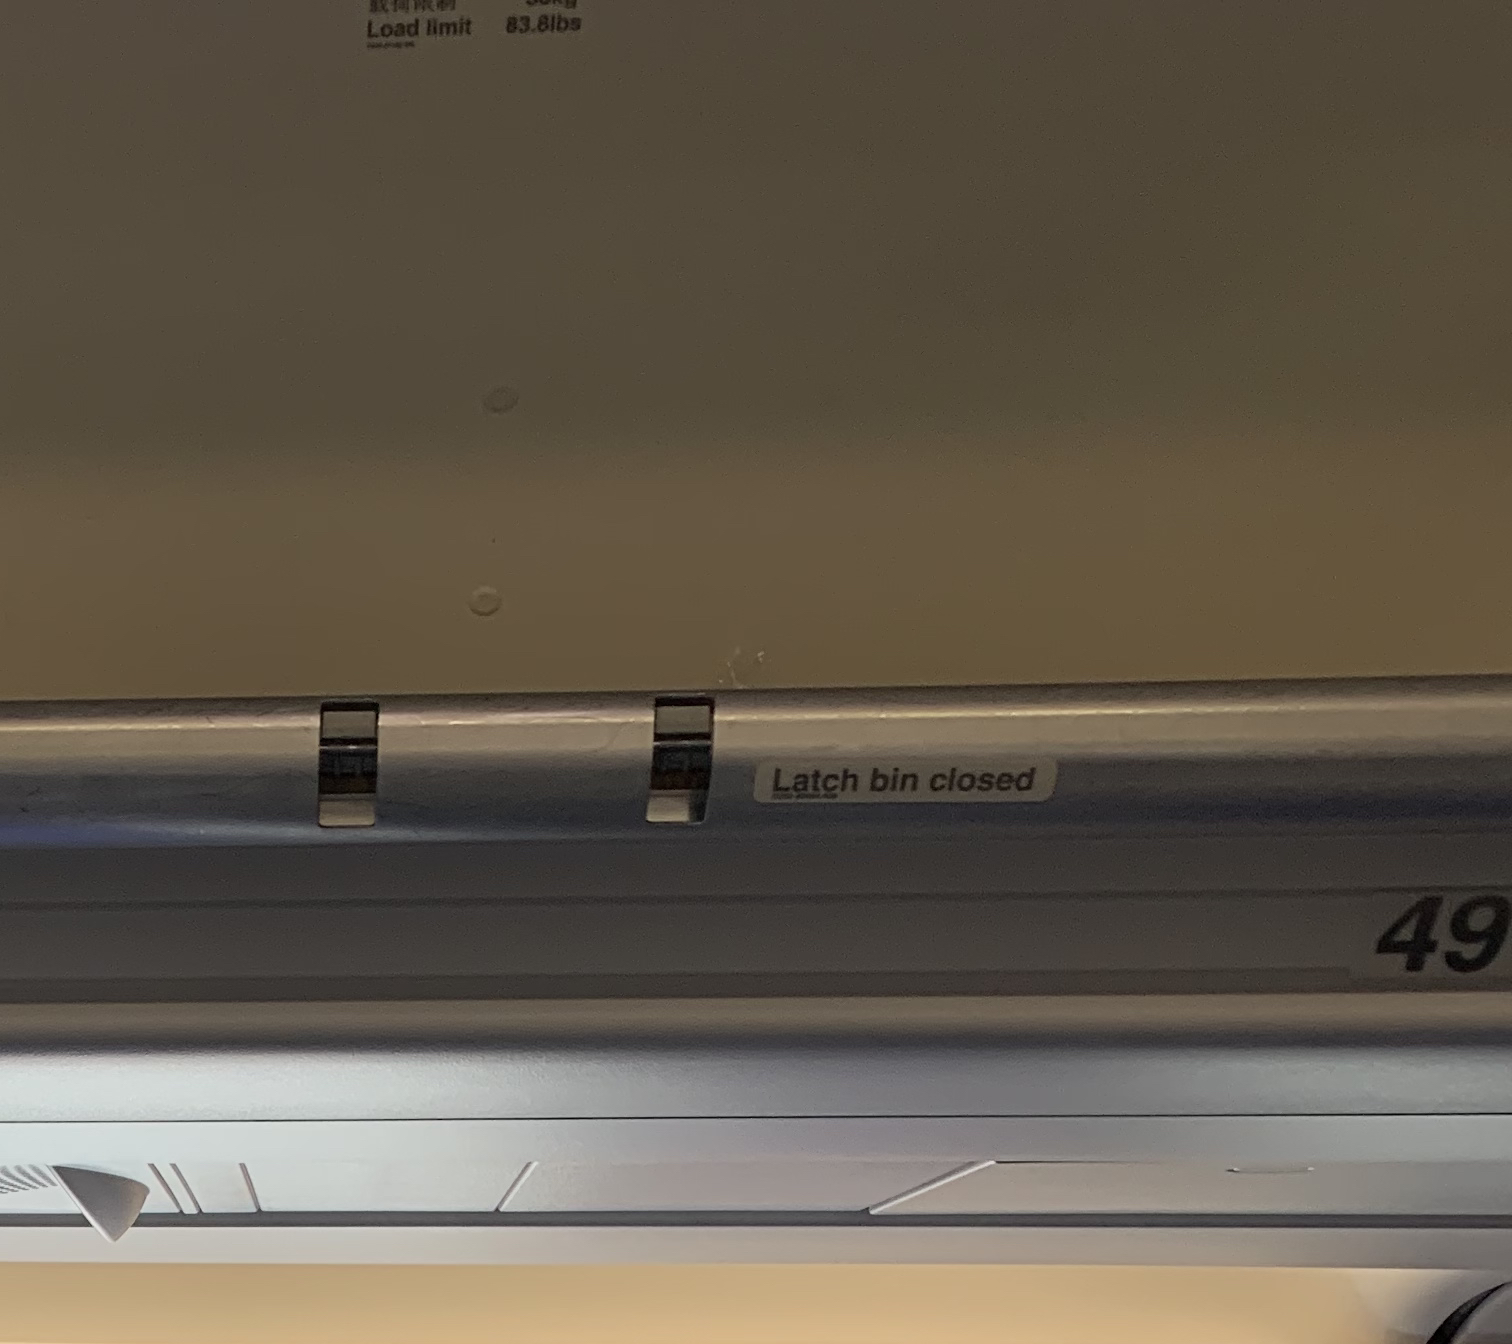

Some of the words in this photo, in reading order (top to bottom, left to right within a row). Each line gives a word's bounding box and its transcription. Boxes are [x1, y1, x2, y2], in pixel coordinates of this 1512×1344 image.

[366, 18, 420, 38] Load
[426, 16, 473, 36] limit
[772, 767, 859, 793] Latch
[869, 767, 919, 792] bin
[929, 766, 1038, 793] closed
[1375, 895, 1512, 973] 49
